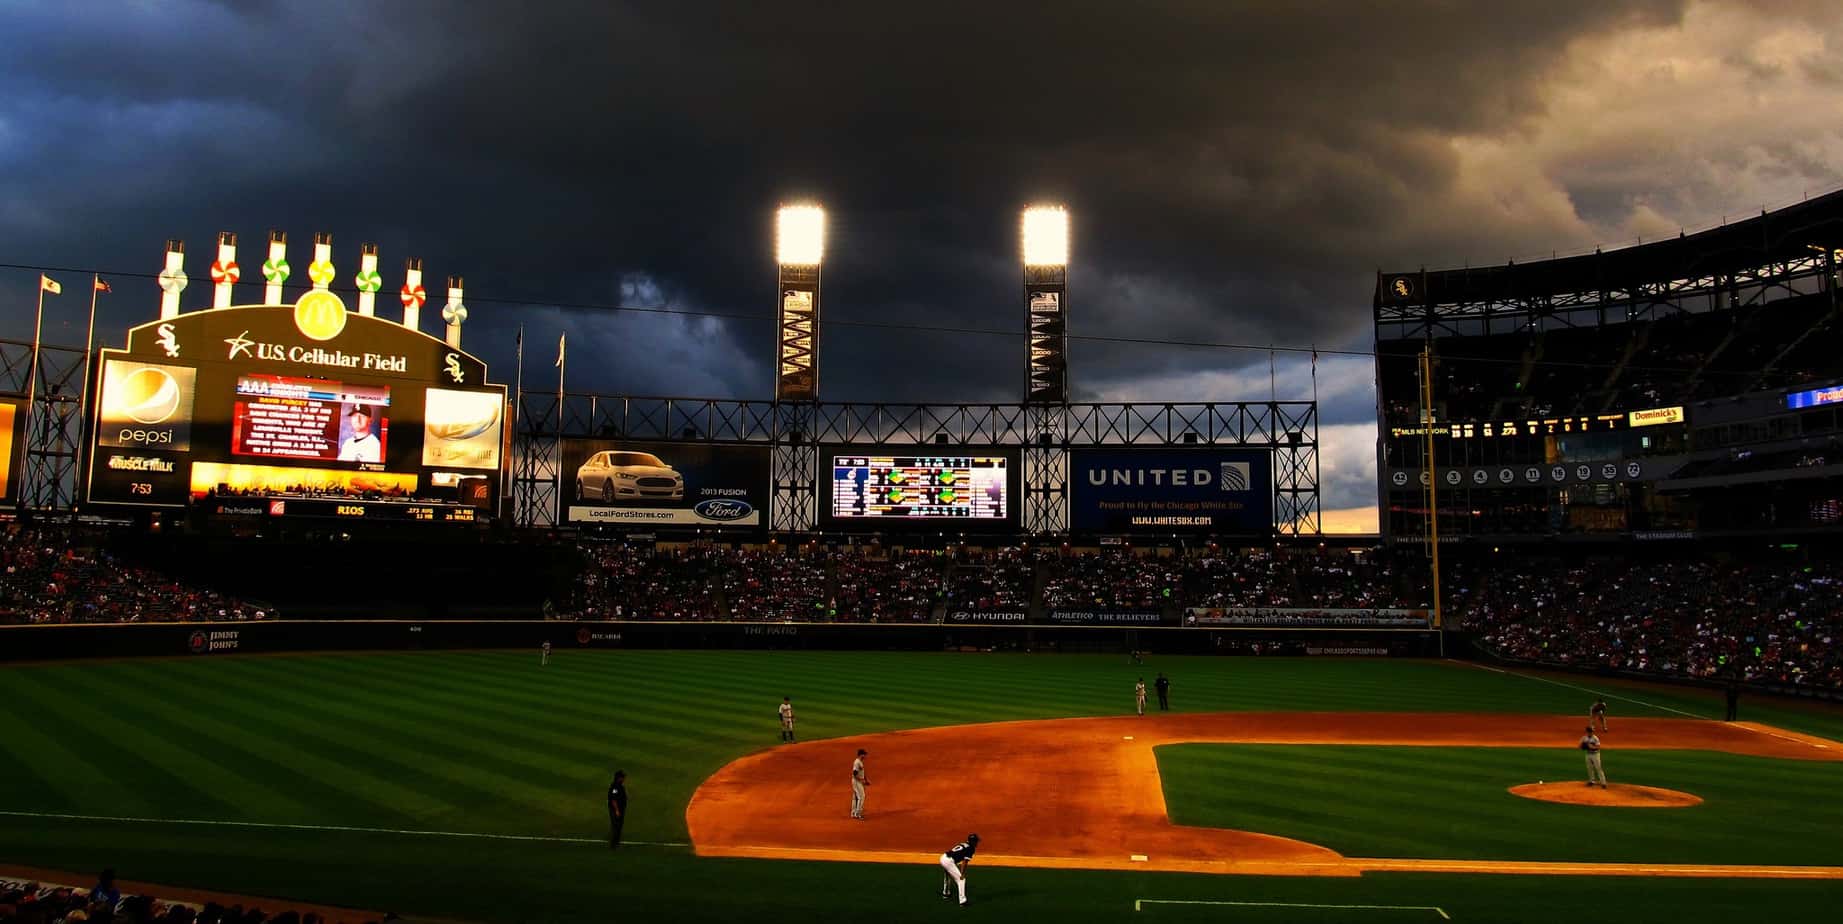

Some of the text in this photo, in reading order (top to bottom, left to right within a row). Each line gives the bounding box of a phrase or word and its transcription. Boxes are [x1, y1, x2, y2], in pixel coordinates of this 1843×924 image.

[257, 343, 406, 373] U.S. Cellular Field
[240, 380, 270, 394] AAA
[119, 427, 173, 445] pepsi
[109, 457, 149, 471] MUSCLE
[1089, 469, 1212, 485] UNITED
[700, 487, 747, 496] 2013 FUSION
[337, 505, 365, 516] RIOS
[706, 501, 742, 518] Ford
[1098, 500, 1125, 510] Proud
[1126, 501, 1136, 510] to
[1151, 501, 1165, 510] the
[1167, 501, 1199, 512] Chicago
[589, 509, 675, 519] LocalFordStores.com
[1132, 515, 1212, 526] WWW.WHITESOX.COM
[972, 612, 1025, 621] HYUNDAI
[1098, 613, 1114, 621] THE
[210, 631, 239, 640] JIMMY
